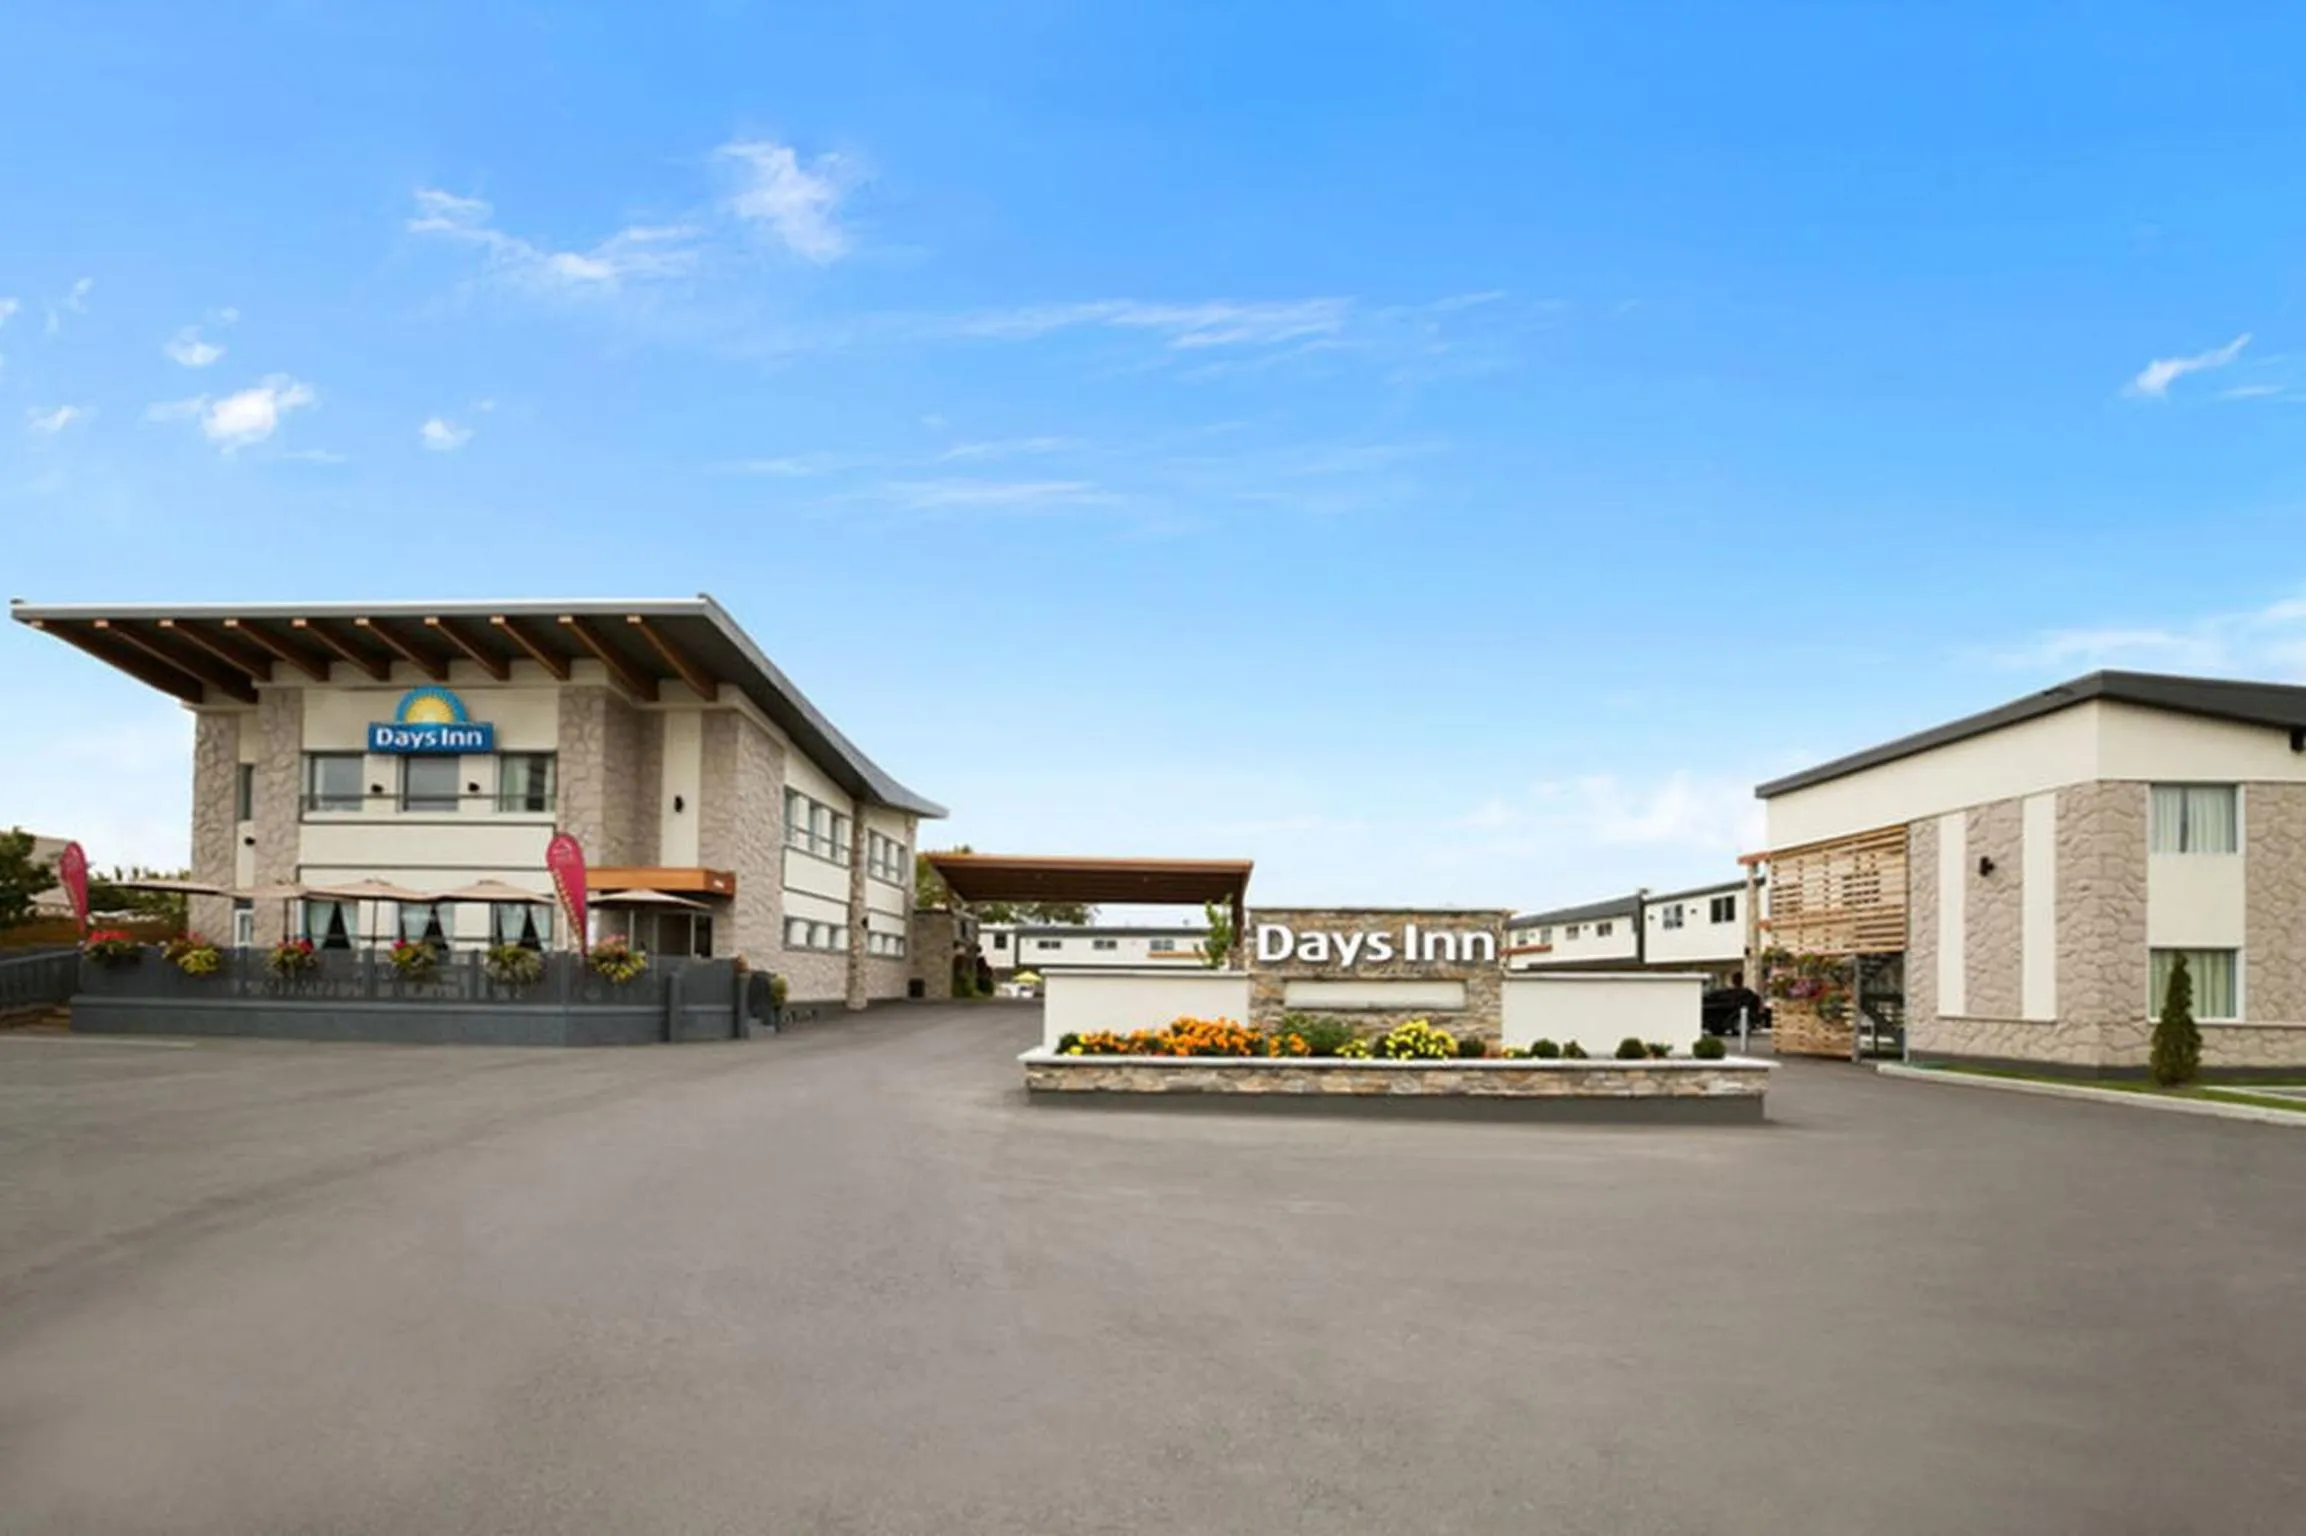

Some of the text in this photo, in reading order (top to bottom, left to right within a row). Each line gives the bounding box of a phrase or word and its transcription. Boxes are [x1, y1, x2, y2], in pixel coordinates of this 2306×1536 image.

[375, 728, 483, 748] Days Inn
[1256, 924, 1495, 967] Days Inn
